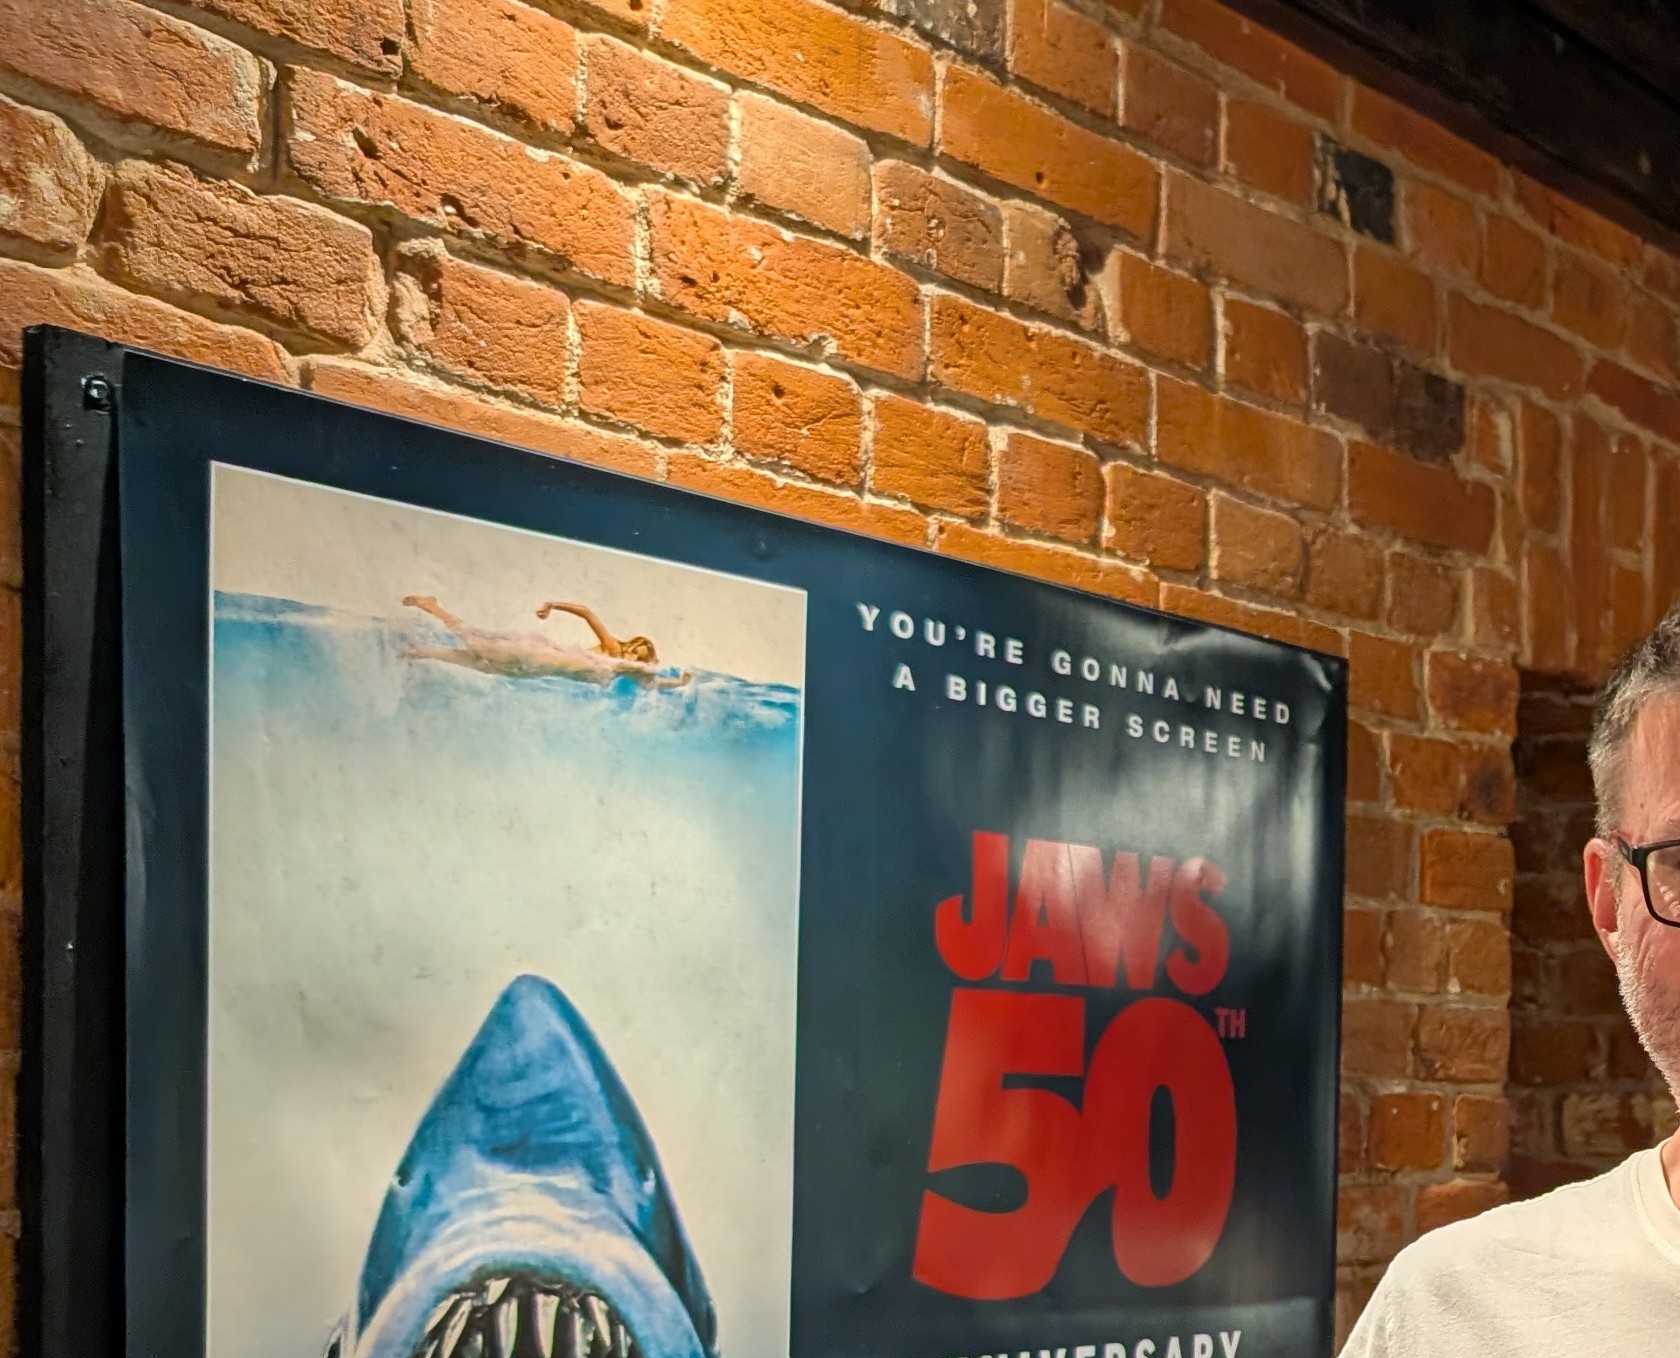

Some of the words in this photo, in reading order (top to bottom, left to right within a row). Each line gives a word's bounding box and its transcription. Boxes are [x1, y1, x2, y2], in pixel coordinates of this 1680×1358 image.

[856, 603, 1024, 664] YOU'RE
[1051, 650, 1180, 700] GONNA
[1205, 687, 1291, 725] NEED
[893, 664, 917, 692] A
[945, 675, 1101, 729] BIGGER
[1127, 715, 1267, 762] SCREEN
[935, 830, 1231, 995] JAWS
[911, 988, 1238, 1300] 50
[1216, 1007, 1247, 1039] TH
